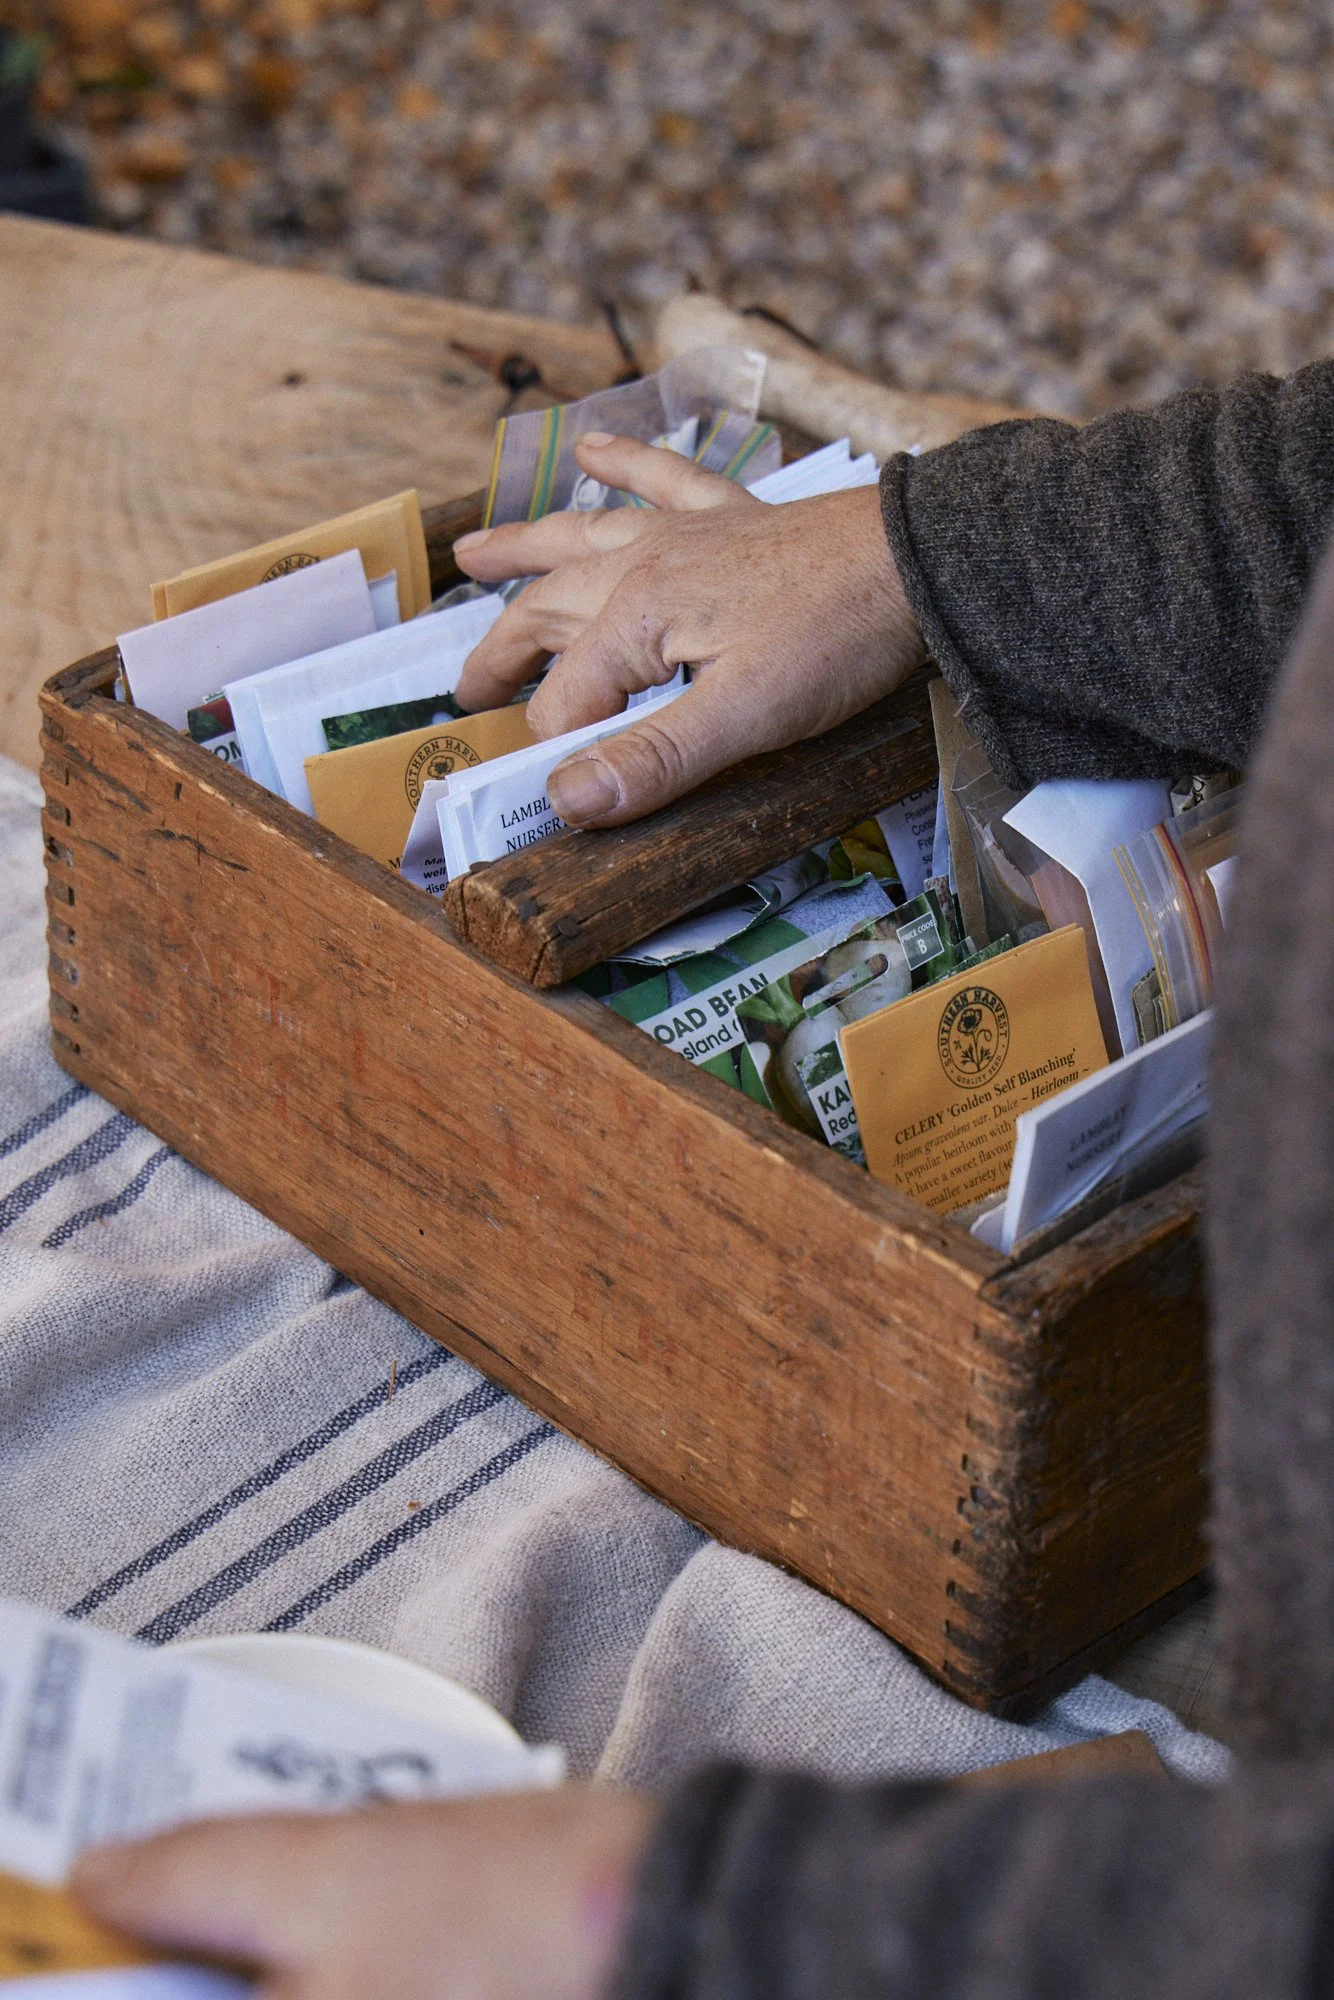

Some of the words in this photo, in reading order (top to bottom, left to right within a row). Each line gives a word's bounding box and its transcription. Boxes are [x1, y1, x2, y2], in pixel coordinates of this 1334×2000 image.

[408, 741, 440, 807] SOUTHERN
[500, 796, 551, 829] LAMBL
[423, 866, 447, 880] well
[917, 938, 928, 955] B
[940, 992, 969, 1068] SOUTHERN
[974, 989, 1008, 1039] HARVEST
[894, 1110, 944, 1146] CELERY
[993, 1073, 1017, 1097] Self
[992, 1098, 1019, 1120] Dulce
[1030, 1070, 1079, 1101] Heirloom
[904, 1154, 942, 1184] popular
[942, 1132, 988, 1162] heirloom
[989, 1118, 1013, 1139] with
[915, 1176, 940, 1195] have
[941, 1171, 949, 1180] a
[949, 1157, 978, 1179] sweet
[979, 1139, 1013, 1164] flavour
[926, 1184, 961, 1208] smaller
[963, 1166, 997, 1192] variety
